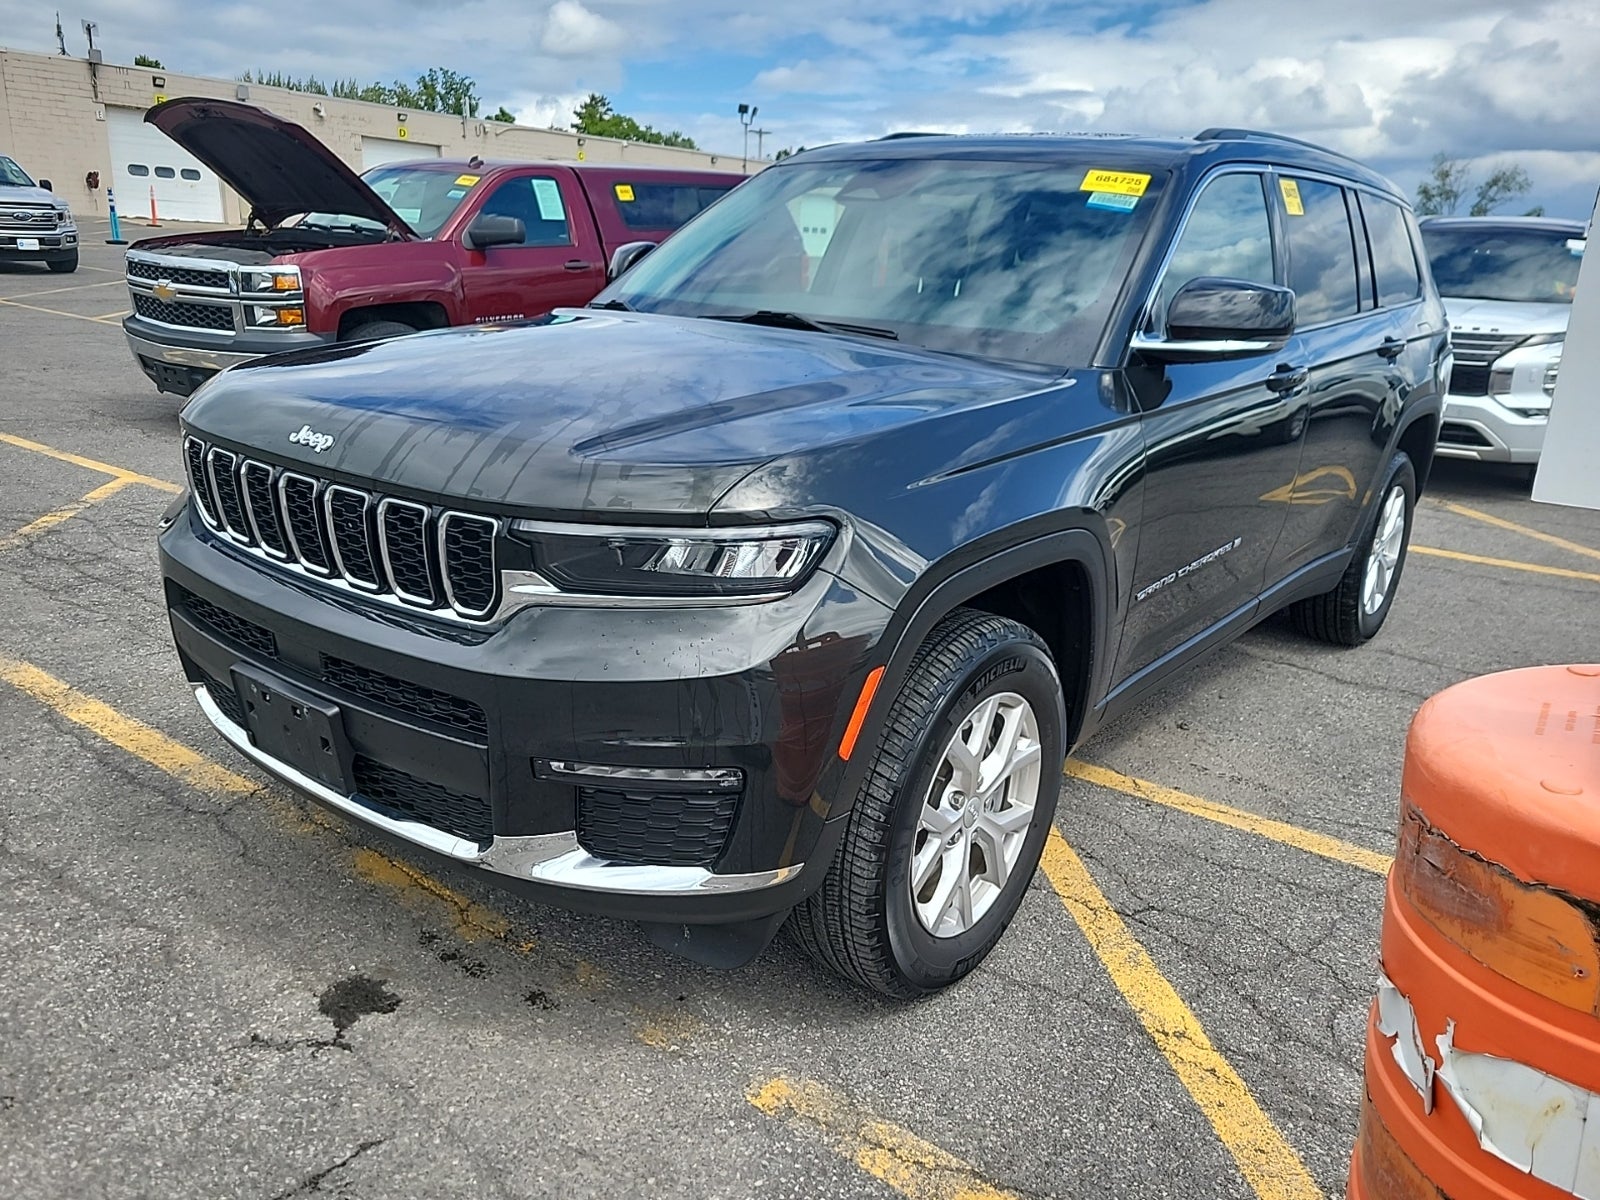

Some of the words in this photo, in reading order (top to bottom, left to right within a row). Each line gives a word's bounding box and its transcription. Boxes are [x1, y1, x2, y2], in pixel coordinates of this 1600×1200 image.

[1095, 174, 1143, 186] 684725
[288, 424, 335, 454] Jeep
[1136, 572, 1177, 601] GRAND
[1177, 541, 1233, 578] CHEROKEE
[975, 656, 1027, 695] MICHELIN
